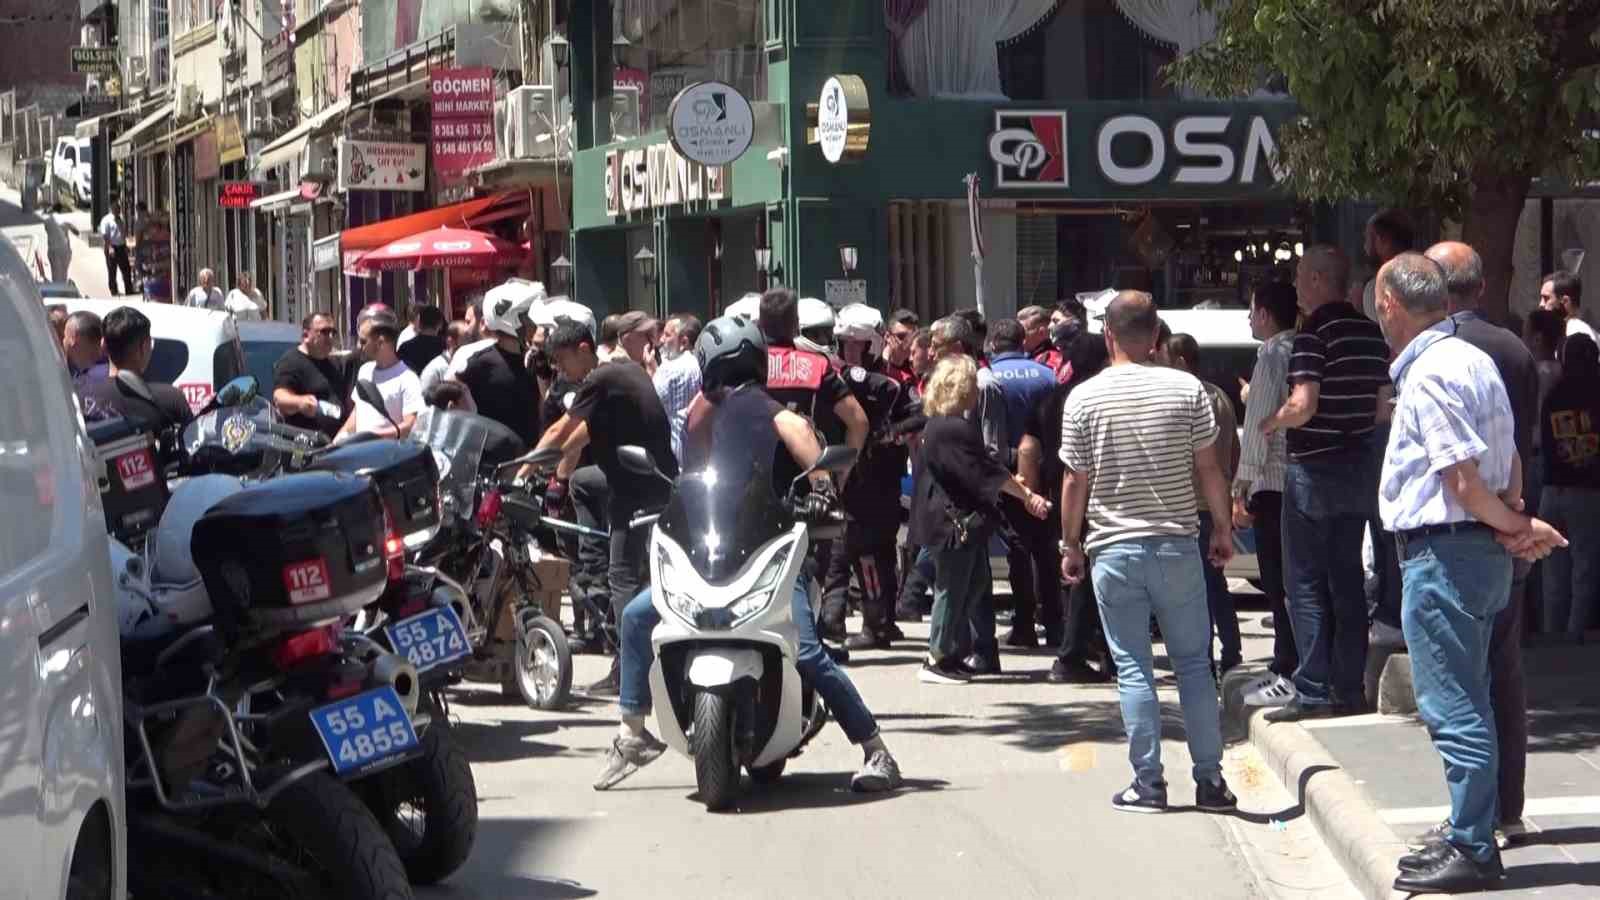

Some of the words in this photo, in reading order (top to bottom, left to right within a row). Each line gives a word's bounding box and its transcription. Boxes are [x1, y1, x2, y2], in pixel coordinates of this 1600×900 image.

[432, 77, 490, 96] GÖÇMEN
[455, 100, 490, 113] MARKET
[182, 385, 207, 403] 112
[121, 453, 148, 475] 112
[289, 565, 323, 589] 112
[395, 621, 428, 648] 55
[436, 614, 455, 633] A
[407, 630, 463, 666] 4874
[326, 704, 366, 736] 55
[373, 697, 397, 722] A
[339, 720, 410, 763] 4855
